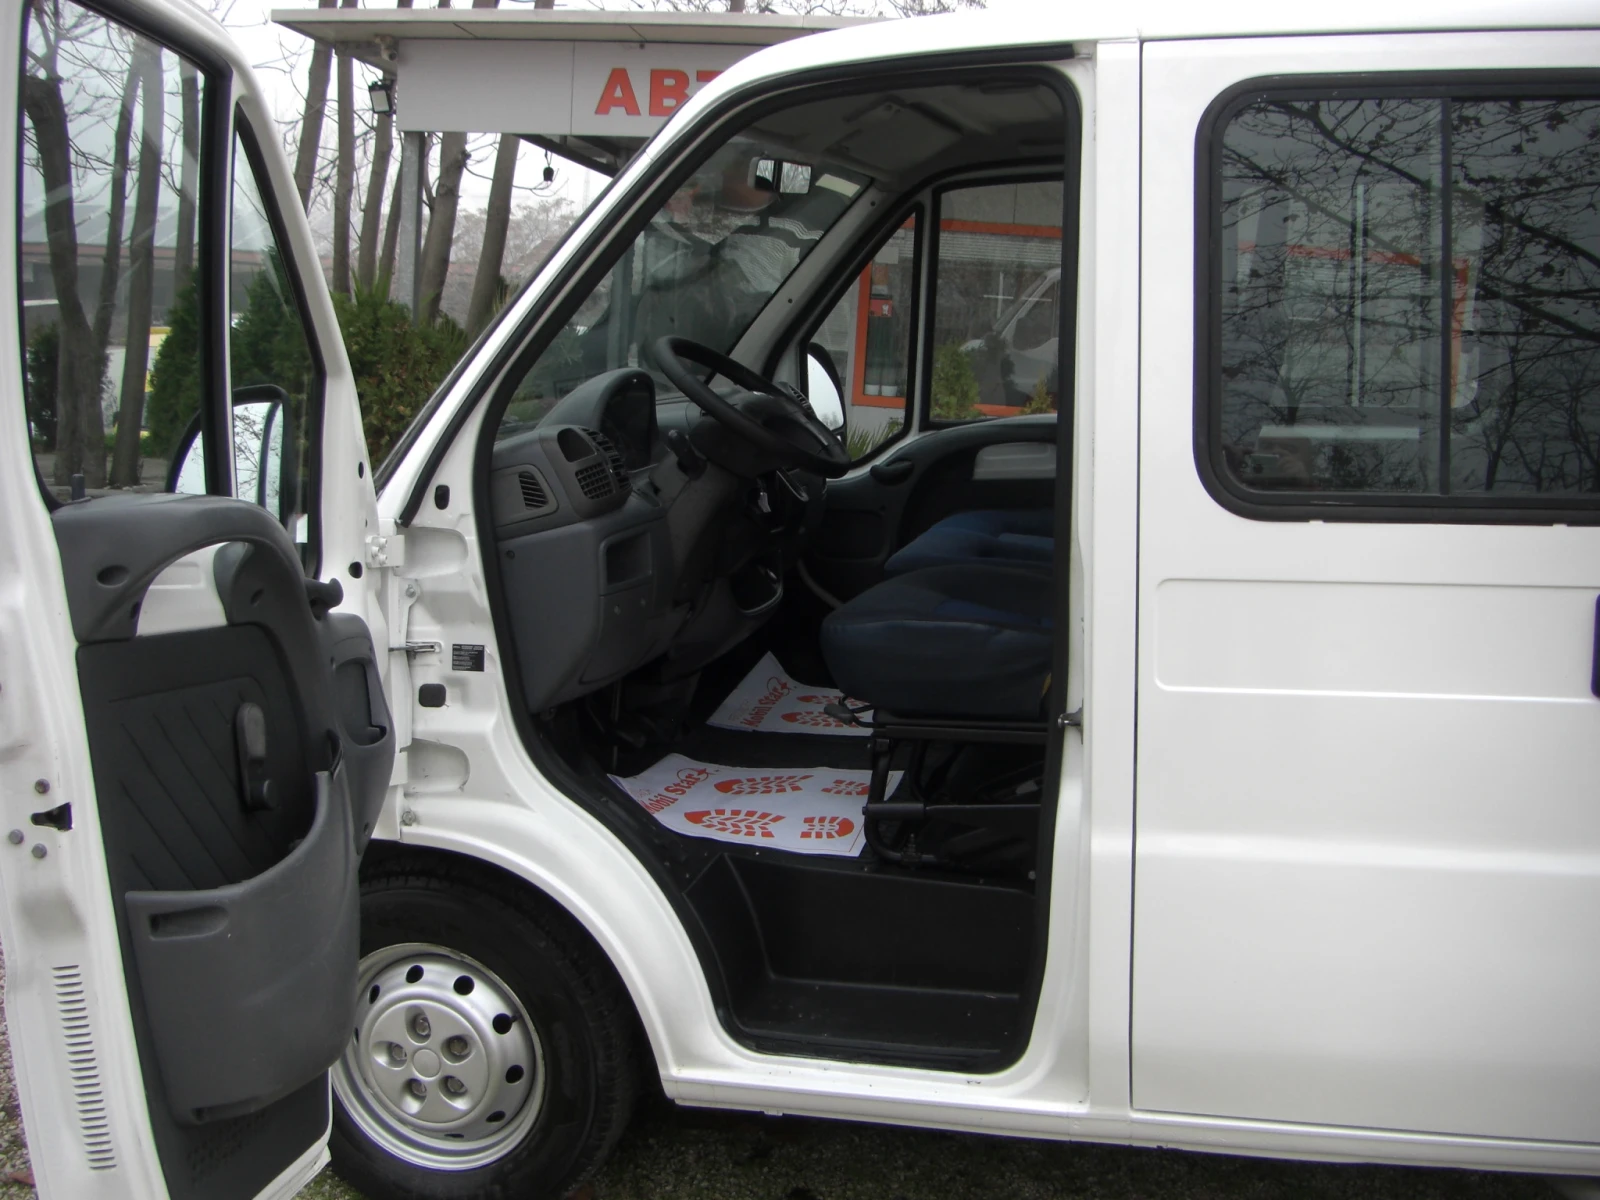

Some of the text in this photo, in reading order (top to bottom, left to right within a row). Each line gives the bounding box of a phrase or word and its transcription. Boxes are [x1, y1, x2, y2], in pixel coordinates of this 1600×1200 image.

[740, 686, 784, 728] Mobil Star
[664, 773, 701, 795] Star
